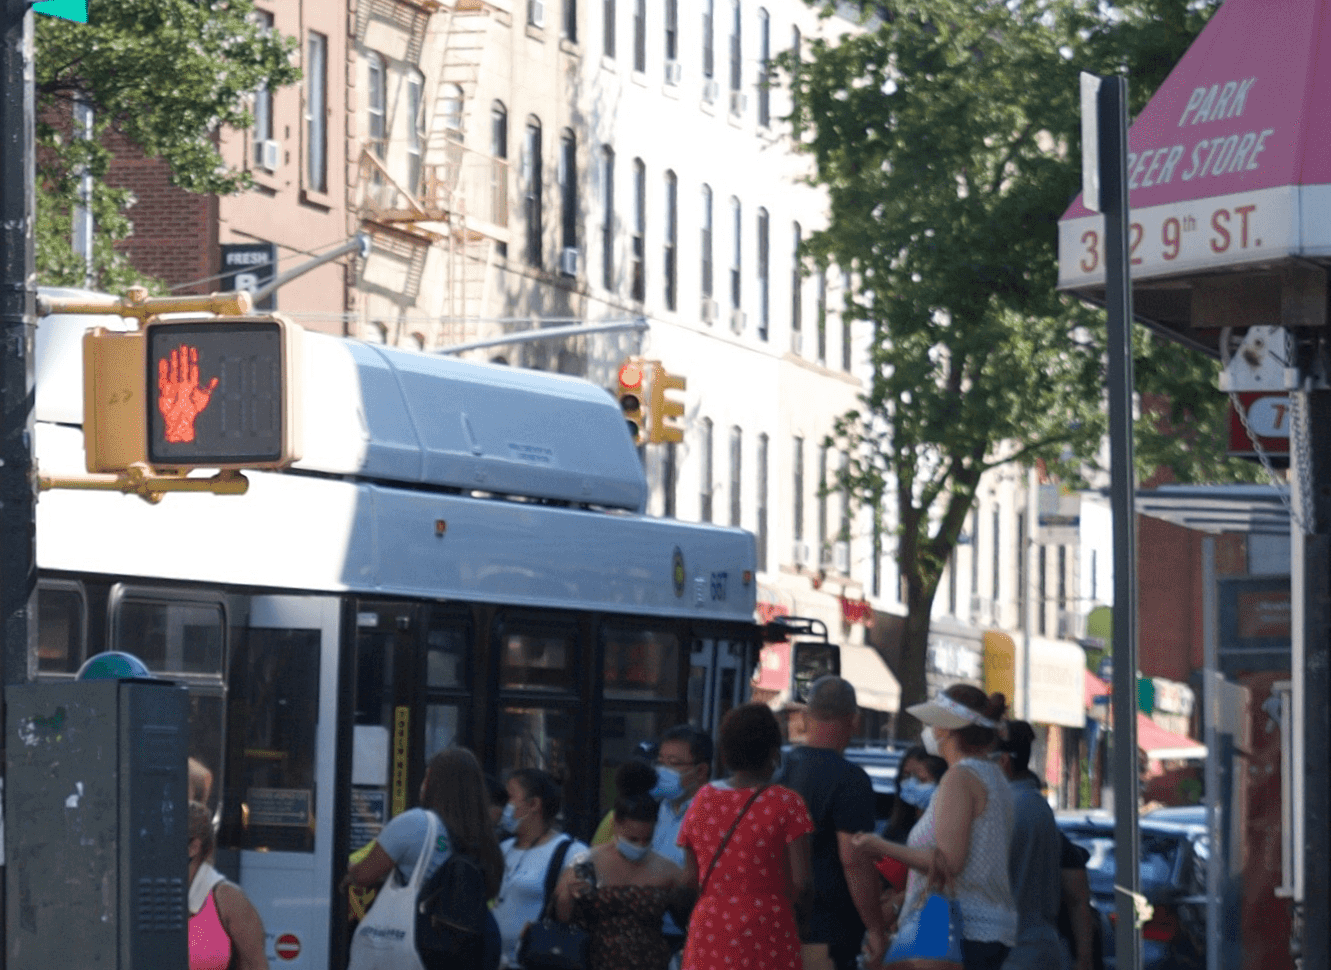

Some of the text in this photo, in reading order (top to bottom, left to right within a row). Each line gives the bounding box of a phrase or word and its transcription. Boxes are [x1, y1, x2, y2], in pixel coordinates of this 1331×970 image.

[1179, 77, 1256, 127] PARK
[1181, 129, 1274, 181] STORE
[226, 251, 269, 266] FRESH
[1079, 204, 1262, 273] 32 9th ST.
